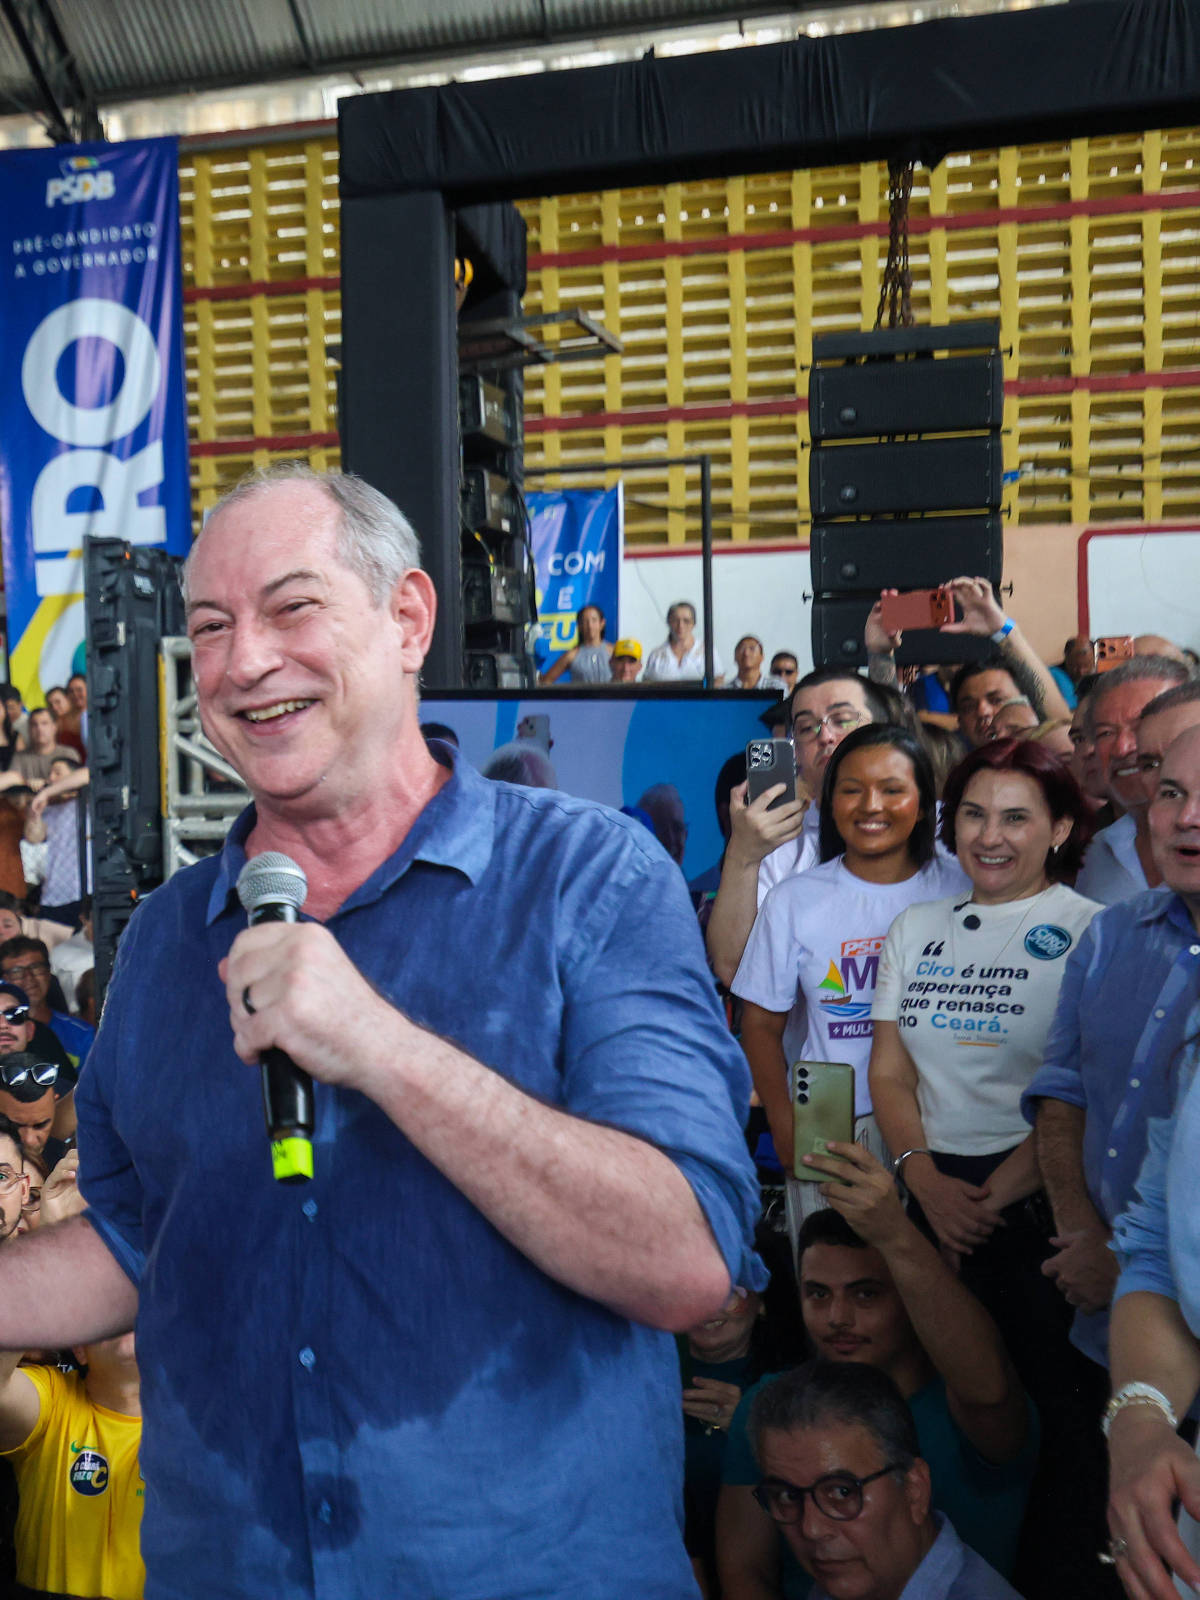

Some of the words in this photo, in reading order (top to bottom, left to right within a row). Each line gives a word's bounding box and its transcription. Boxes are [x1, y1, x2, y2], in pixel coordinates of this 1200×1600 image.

[46, 171, 116, 207] PSDB
[33, 245, 158, 276] GOVERNADOR
[548, 550, 605, 576] COM
[843, 940, 885, 956] PSD
[916, 961, 955, 977] Ciro
[960, 963, 975, 978] é
[979, 967, 1029, 981] uma
[908, 981, 1012, 1000] esperança
[901, 998, 930, 1013] que
[936, 1000, 1025, 1015] renasce
[899, 1015, 918, 1028] no
[931, 1013, 1008, 1034] Ceará.
